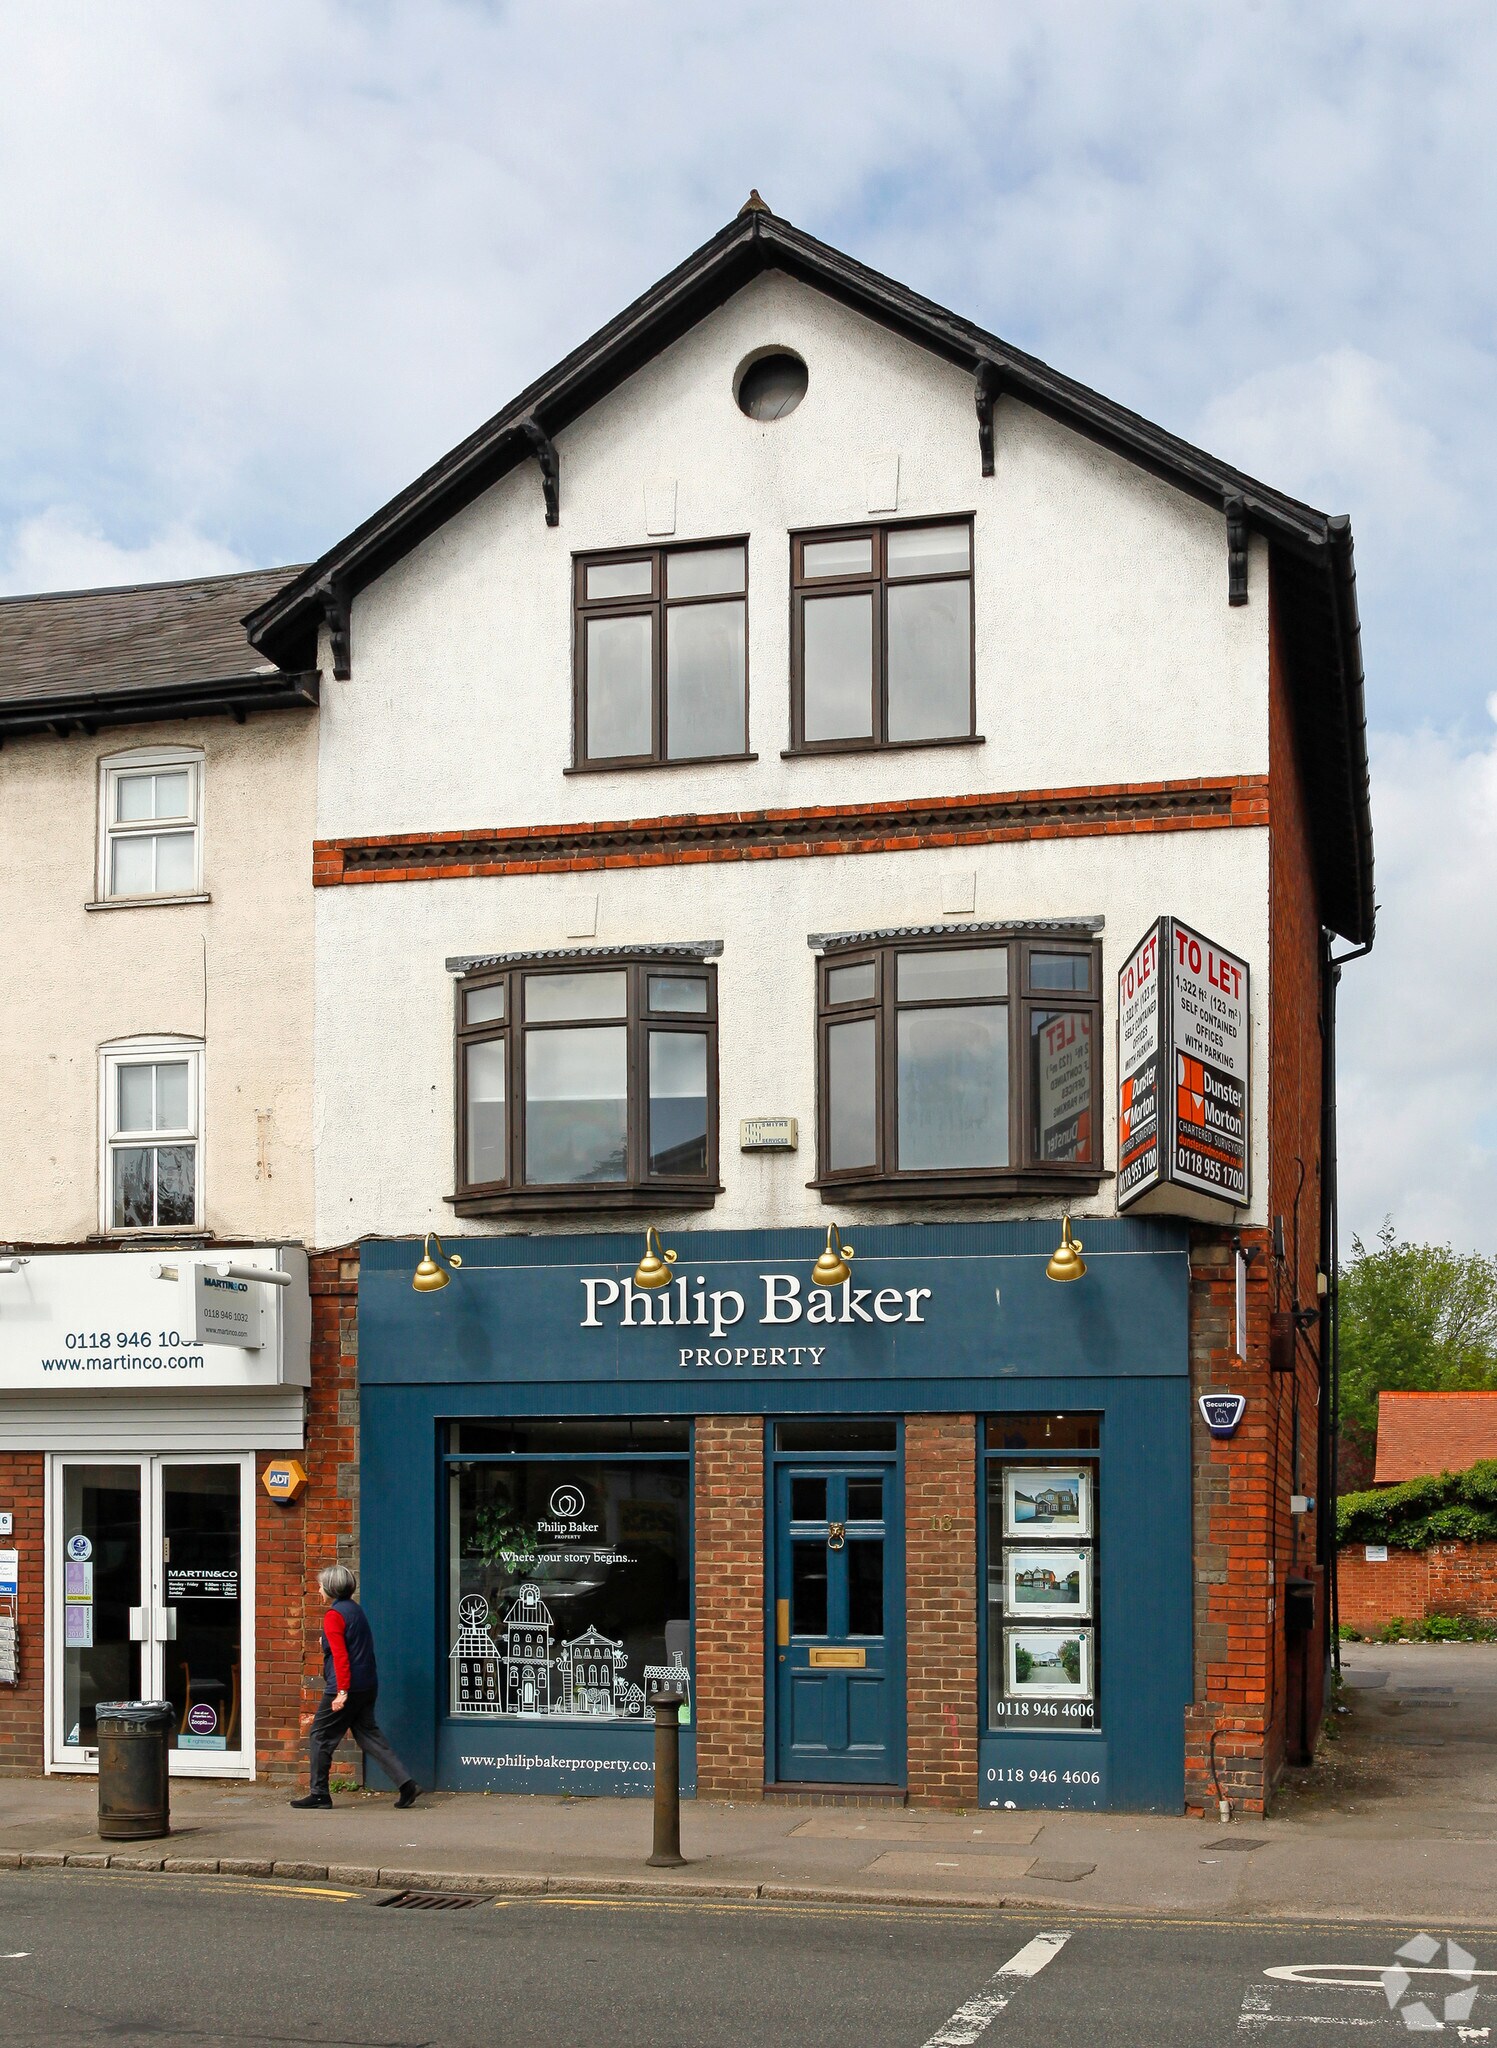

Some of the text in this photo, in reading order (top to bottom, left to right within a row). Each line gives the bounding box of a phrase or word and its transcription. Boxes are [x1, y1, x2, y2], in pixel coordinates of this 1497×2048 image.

[1121, 934, 1156, 1006] TO LET
[1175, 929, 1242, 1000] TO LET
[1176, 975, 1197, 997] 1,322
[1210, 995, 1226, 1015] (123
[1181, 997, 1237, 1038] SELF CONTAINED
[1185, 1033, 1235, 1069] WITH PARKING
[1196, 1023, 1223, 1047] OFFICES
[1132, 1065, 1156, 1100] Dunster
[1204, 1071, 1242, 1107] Dunster
[1129, 1095, 1154, 1127] Morton
[1204, 1099, 1242, 1135] Morton
[1178, 1120, 1245, 1157] CHARTERED SURVEYORS
[1131, 1159, 1142, 1182] 955
[1142, 1148, 1157, 1174] 1700
[1179, 1148, 1202, 1174] 0118
[1204, 1158, 1221, 1181] 955
[1223, 1166, 1244, 1190] 1700
[204, 1277, 248, 1292] MARTIN&CO
[204, 1308, 248, 1322] 0118 946 1032
[580, 1274, 932, 1337] Philip Baker
[65, 1331, 203, 1349] 0118 946 10
[42, 1355, 204, 1371] www.martinco.com
[680, 1347, 827, 1367] PROPERTY
[270, 1474, 289, 1484] ADT
[537, 1521, 599, 1534] Philip Baker
[500, 1552, 638, 1564] Where your story begins...
[997, 1701, 1094, 1717] 0118 946 4606
[987, 1768, 1100, 1784] 0118 946 4606
